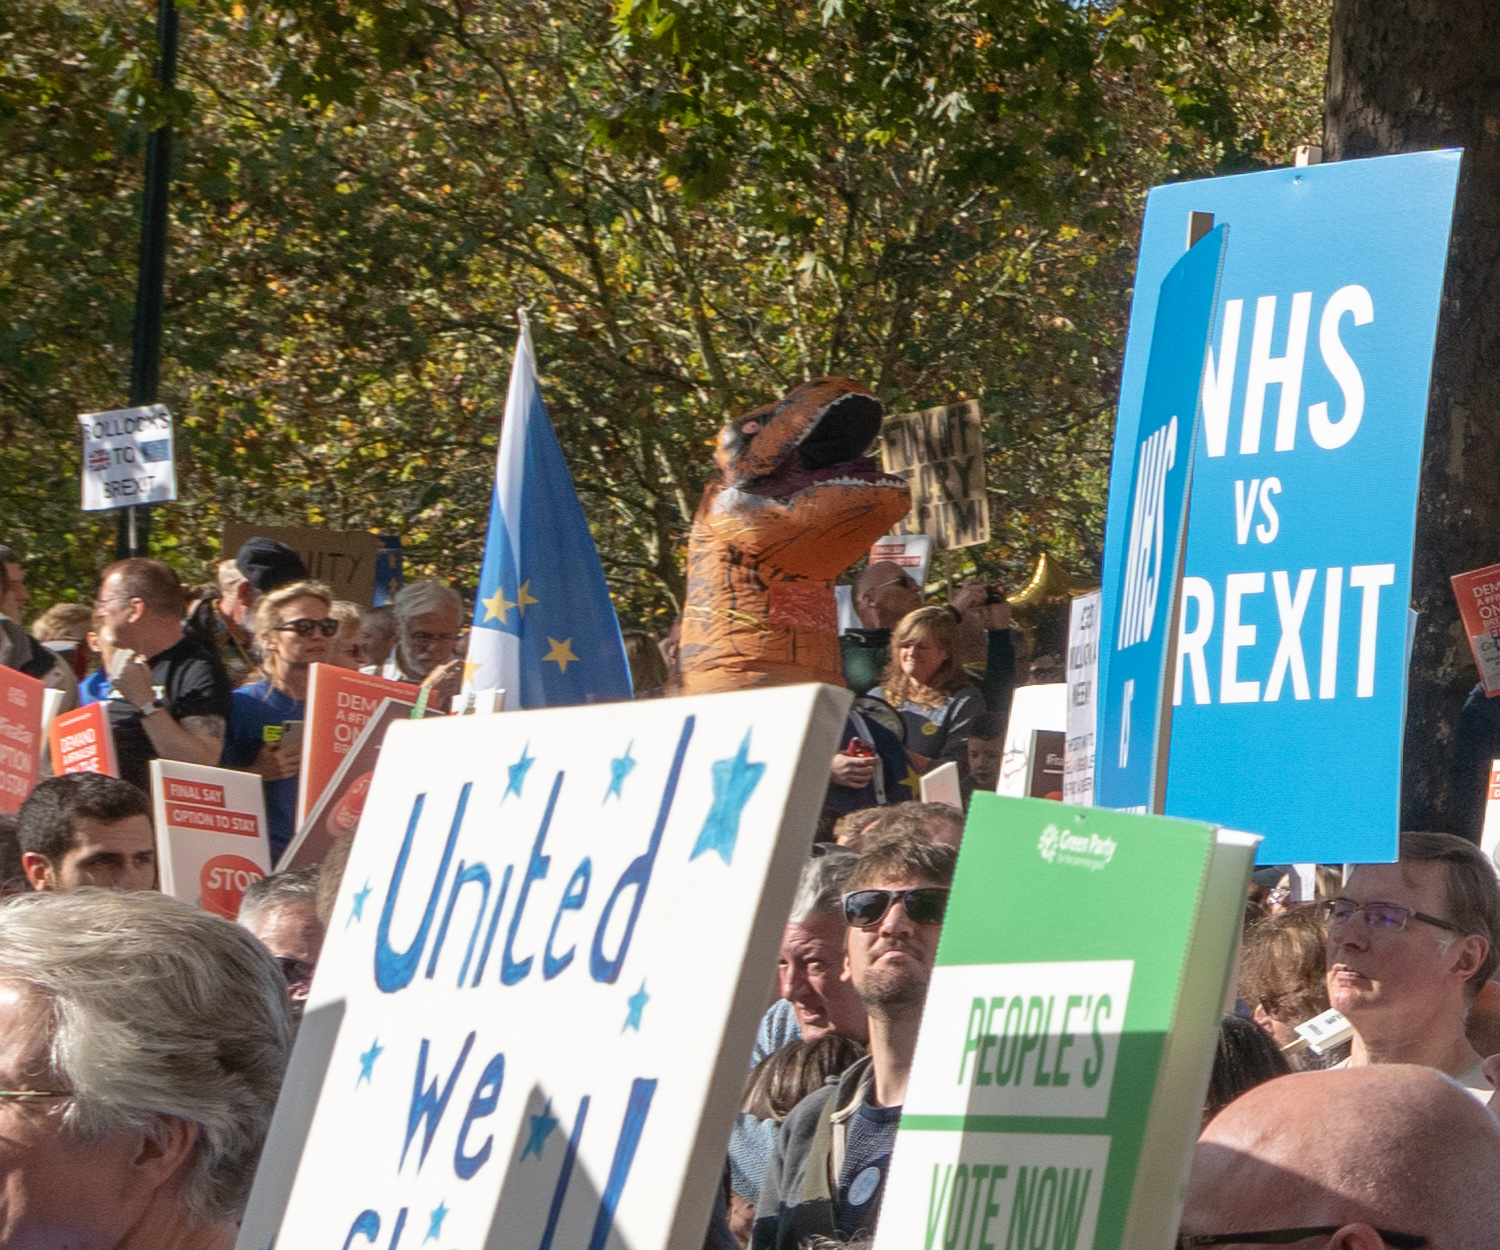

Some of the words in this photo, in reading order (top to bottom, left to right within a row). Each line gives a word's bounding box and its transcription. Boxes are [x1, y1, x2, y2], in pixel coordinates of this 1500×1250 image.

[1202, 284, 1375, 457] NHS
[112, 446, 135, 465] TO
[1234, 476, 1283, 546] VS
[1172, 563, 1396, 707] REXIT
[337, 691, 377, 712] DEM
[170, 783, 202, 800] FINAL
[202, 788, 223, 803] SAY
[173, 809, 214, 827] OPTION
[215, 815, 230, 828] TO
[231, 818, 256, 833] STAY
[1059, 829, 1090, 853] Green
[1089, 833, 1118, 864] Party
[373, 714, 697, 994] United
[957, 993, 1112, 1088] PEOPLE'S
